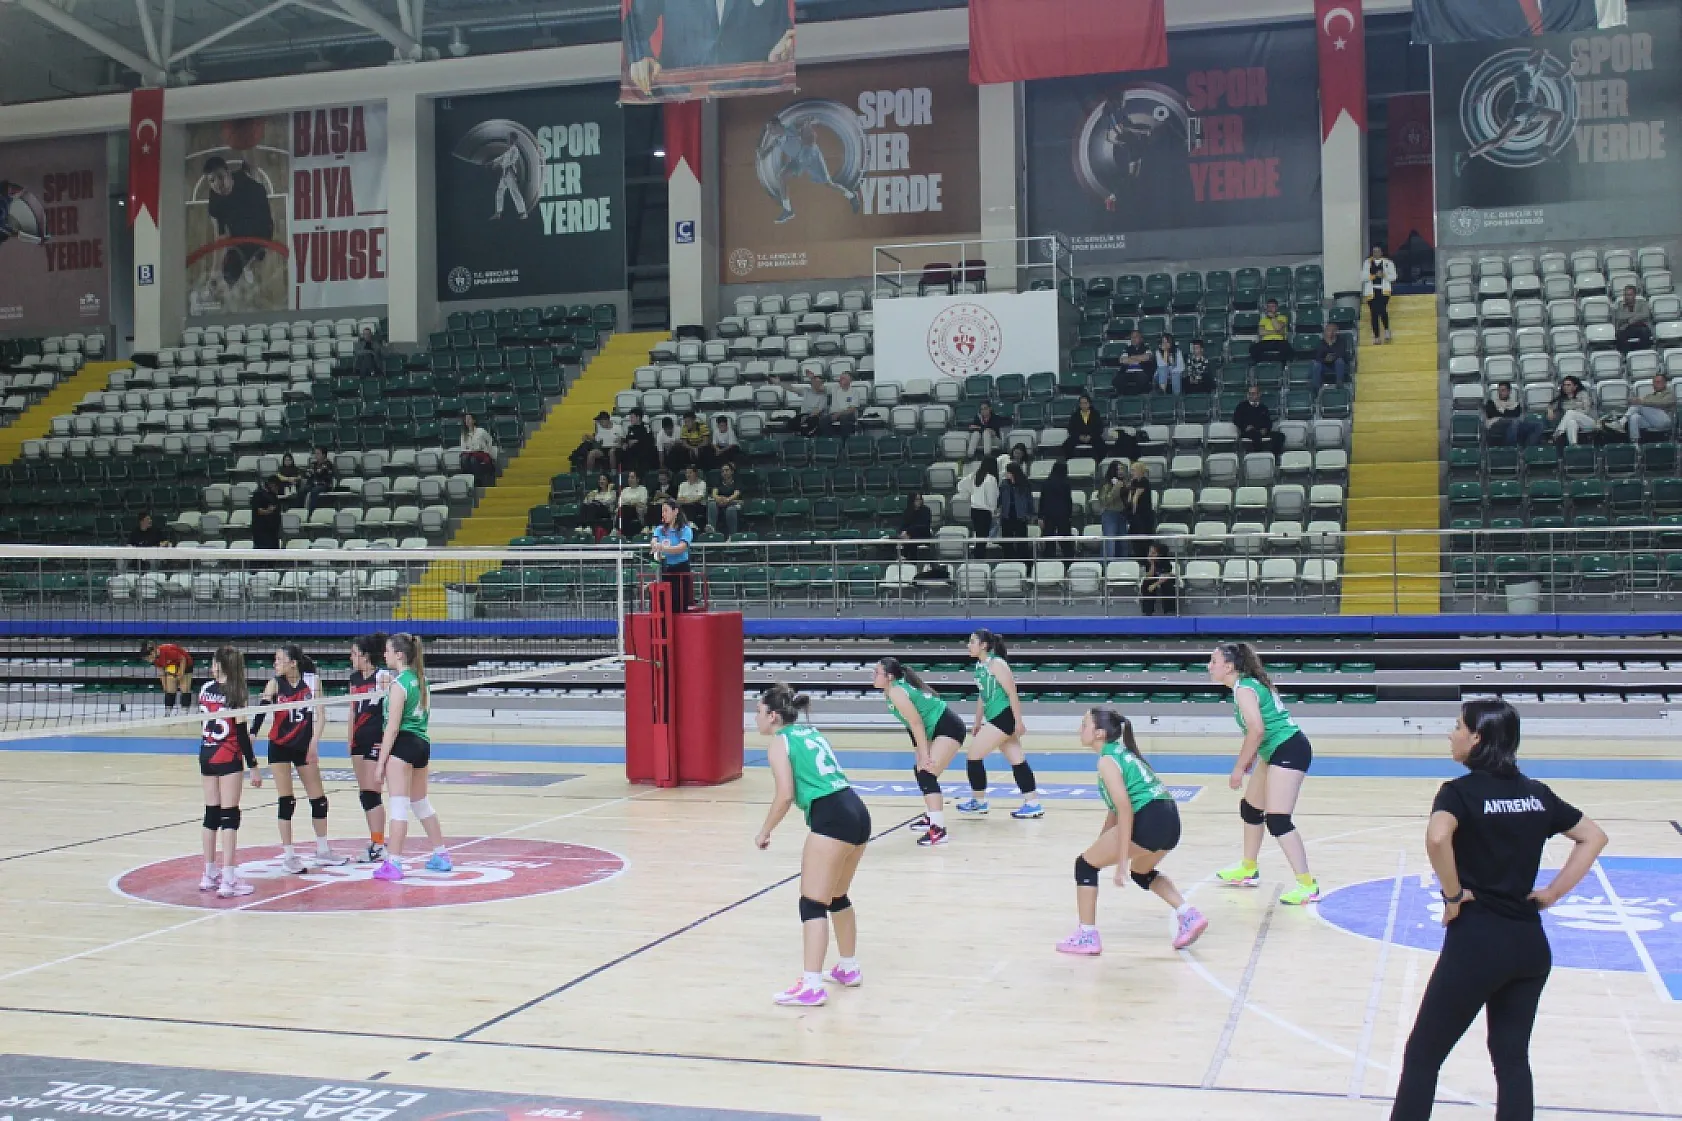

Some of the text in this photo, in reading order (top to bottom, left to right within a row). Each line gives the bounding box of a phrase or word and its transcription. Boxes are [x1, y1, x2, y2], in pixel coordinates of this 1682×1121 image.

[1570, 32, 1654, 76] SPOR
[858, 87, 932, 129] SPOR
[1186, 66, 1268, 111] SPOR
[1576, 78, 1629, 120] HER
[293, 105, 367, 161] BAŞA
[537, 122, 601, 159] SPOR
[1575, 120, 1667, 163] YERDE
[43, 169, 94, 203] SPOR
[293, 166, 354, 220] RIYA
[541, 161, 582, 198] HER
[859, 173, 943, 215] YERDE
[1188, 157, 1282, 202] YERDE
[539, 196, 612, 235] YERDE
[679, 221, 692, 236] C
[45, 238, 103, 272] YERDE
[141, 265, 151, 279] B
[293, 225, 388, 284] YÜKSE
[804, 736, 842, 776] 21
[40, 1081, 398, 1121] BASKETBOL
